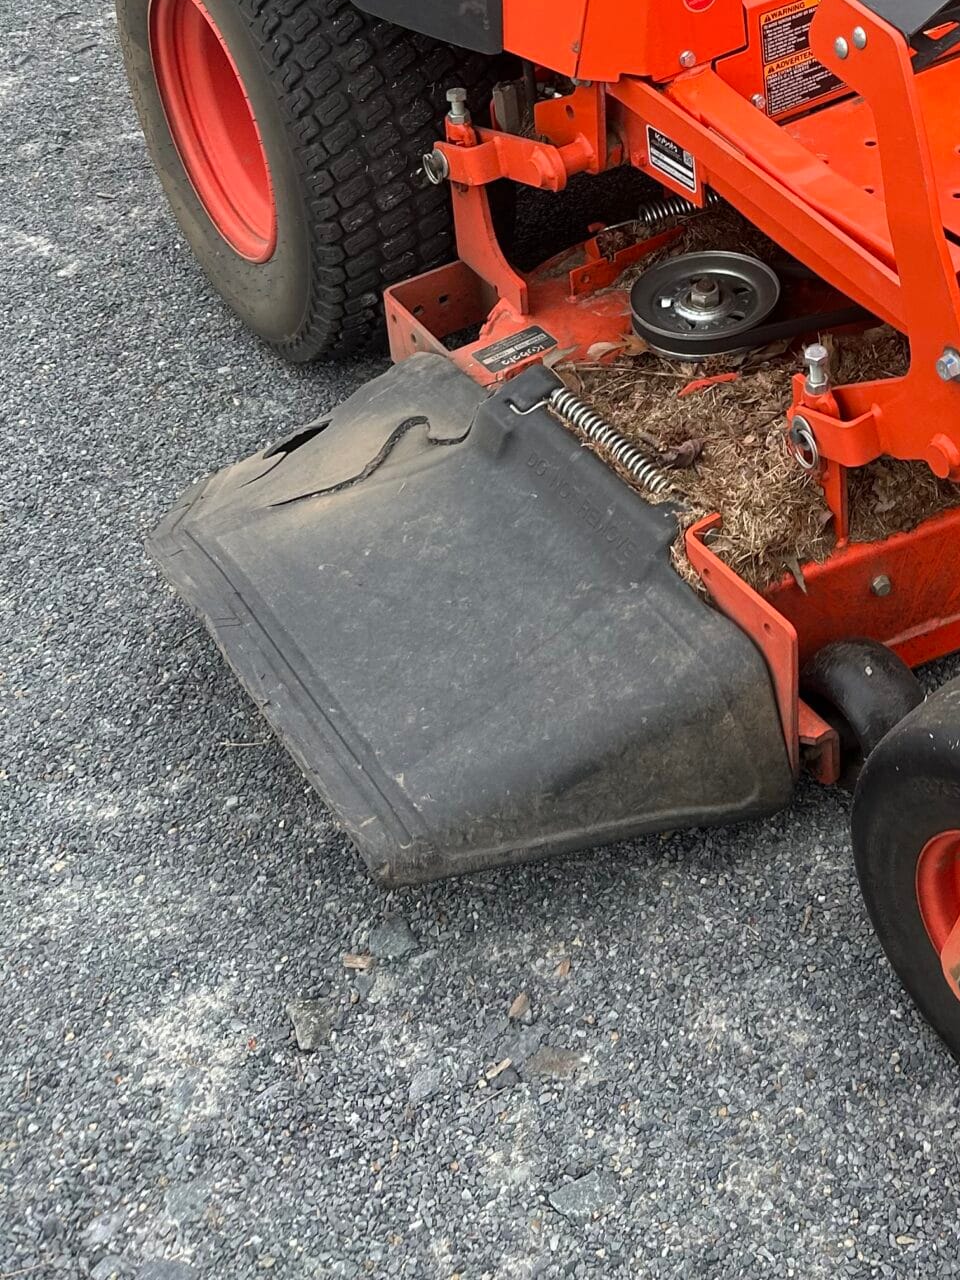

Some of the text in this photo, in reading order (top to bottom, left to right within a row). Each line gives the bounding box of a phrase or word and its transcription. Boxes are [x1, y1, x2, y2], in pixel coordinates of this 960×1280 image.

[770, 1, 805, 19] WARNING
[775, 51, 814, 70] ADVERTEN
[501, 344, 545, 366] Kubota
